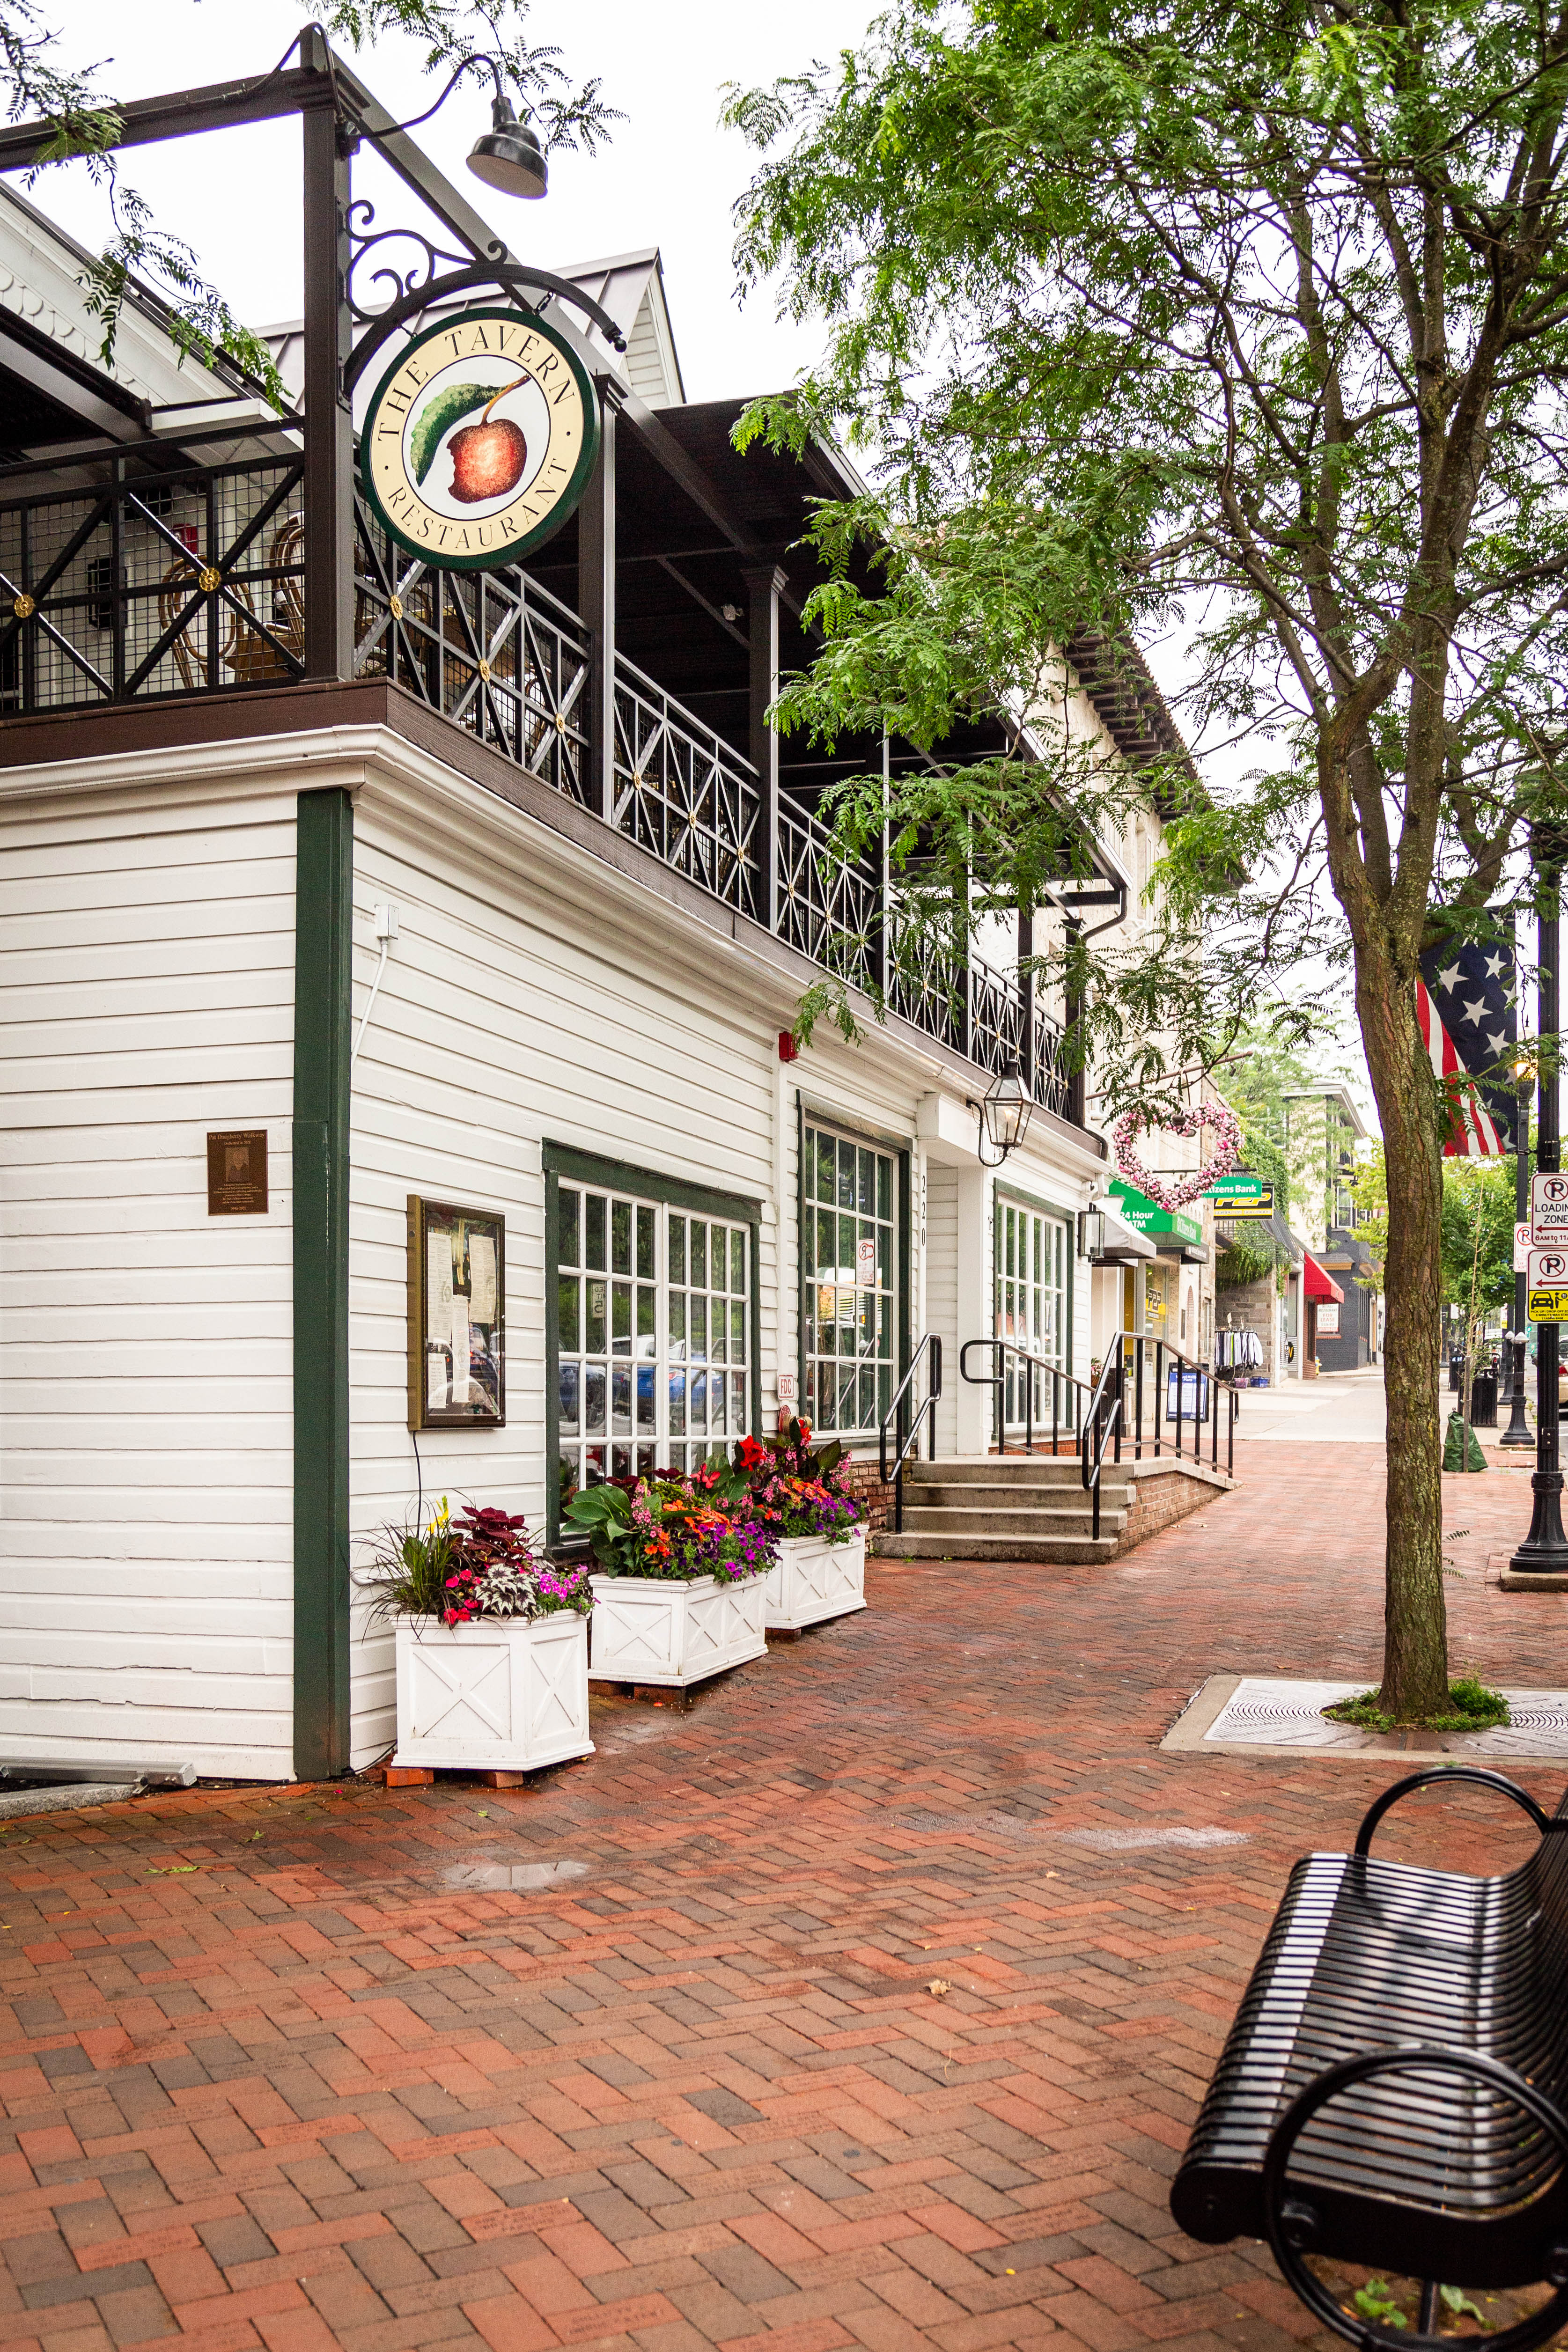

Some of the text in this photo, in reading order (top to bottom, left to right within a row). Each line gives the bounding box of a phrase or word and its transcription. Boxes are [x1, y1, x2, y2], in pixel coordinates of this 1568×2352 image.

[378, 325, 575, 441] THE TAVERN
[387, 458, 567, 549] RESTAURANT
[1235, 1184, 1257, 1193] Bank
[1535, 1204, 1568, 1213] LOADIN
[1544, 1215, 1568, 1223] ZONE
[780, 1379, 791, 1394] FDC
